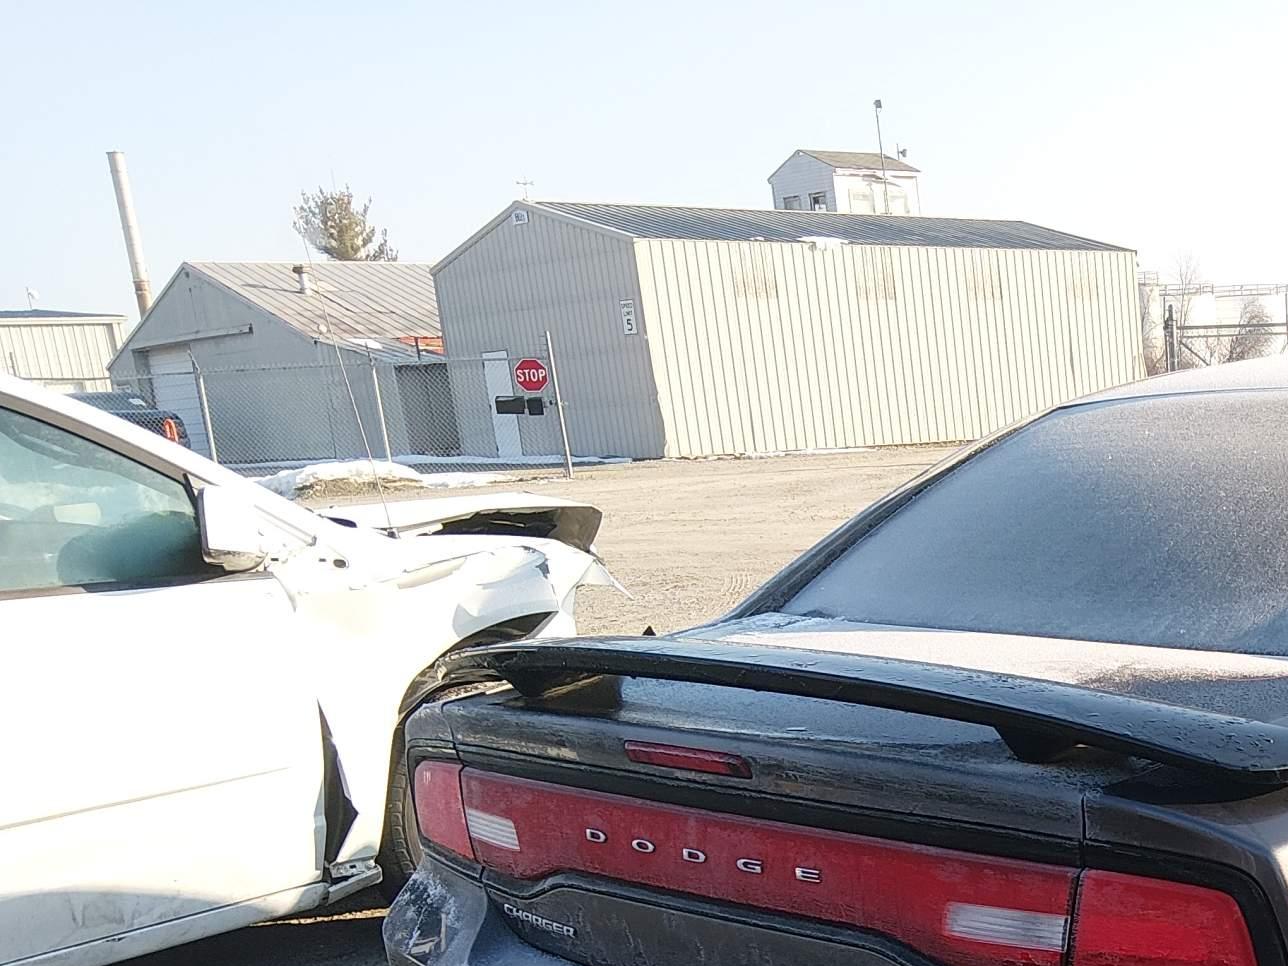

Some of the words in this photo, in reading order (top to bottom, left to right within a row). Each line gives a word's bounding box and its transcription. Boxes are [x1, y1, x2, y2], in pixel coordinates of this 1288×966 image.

[626, 318, 634, 332] 5
[516, 368, 546, 383] STOP
[585, 827, 823, 883] DODGE
[503, 903, 576, 939] CHARGER
